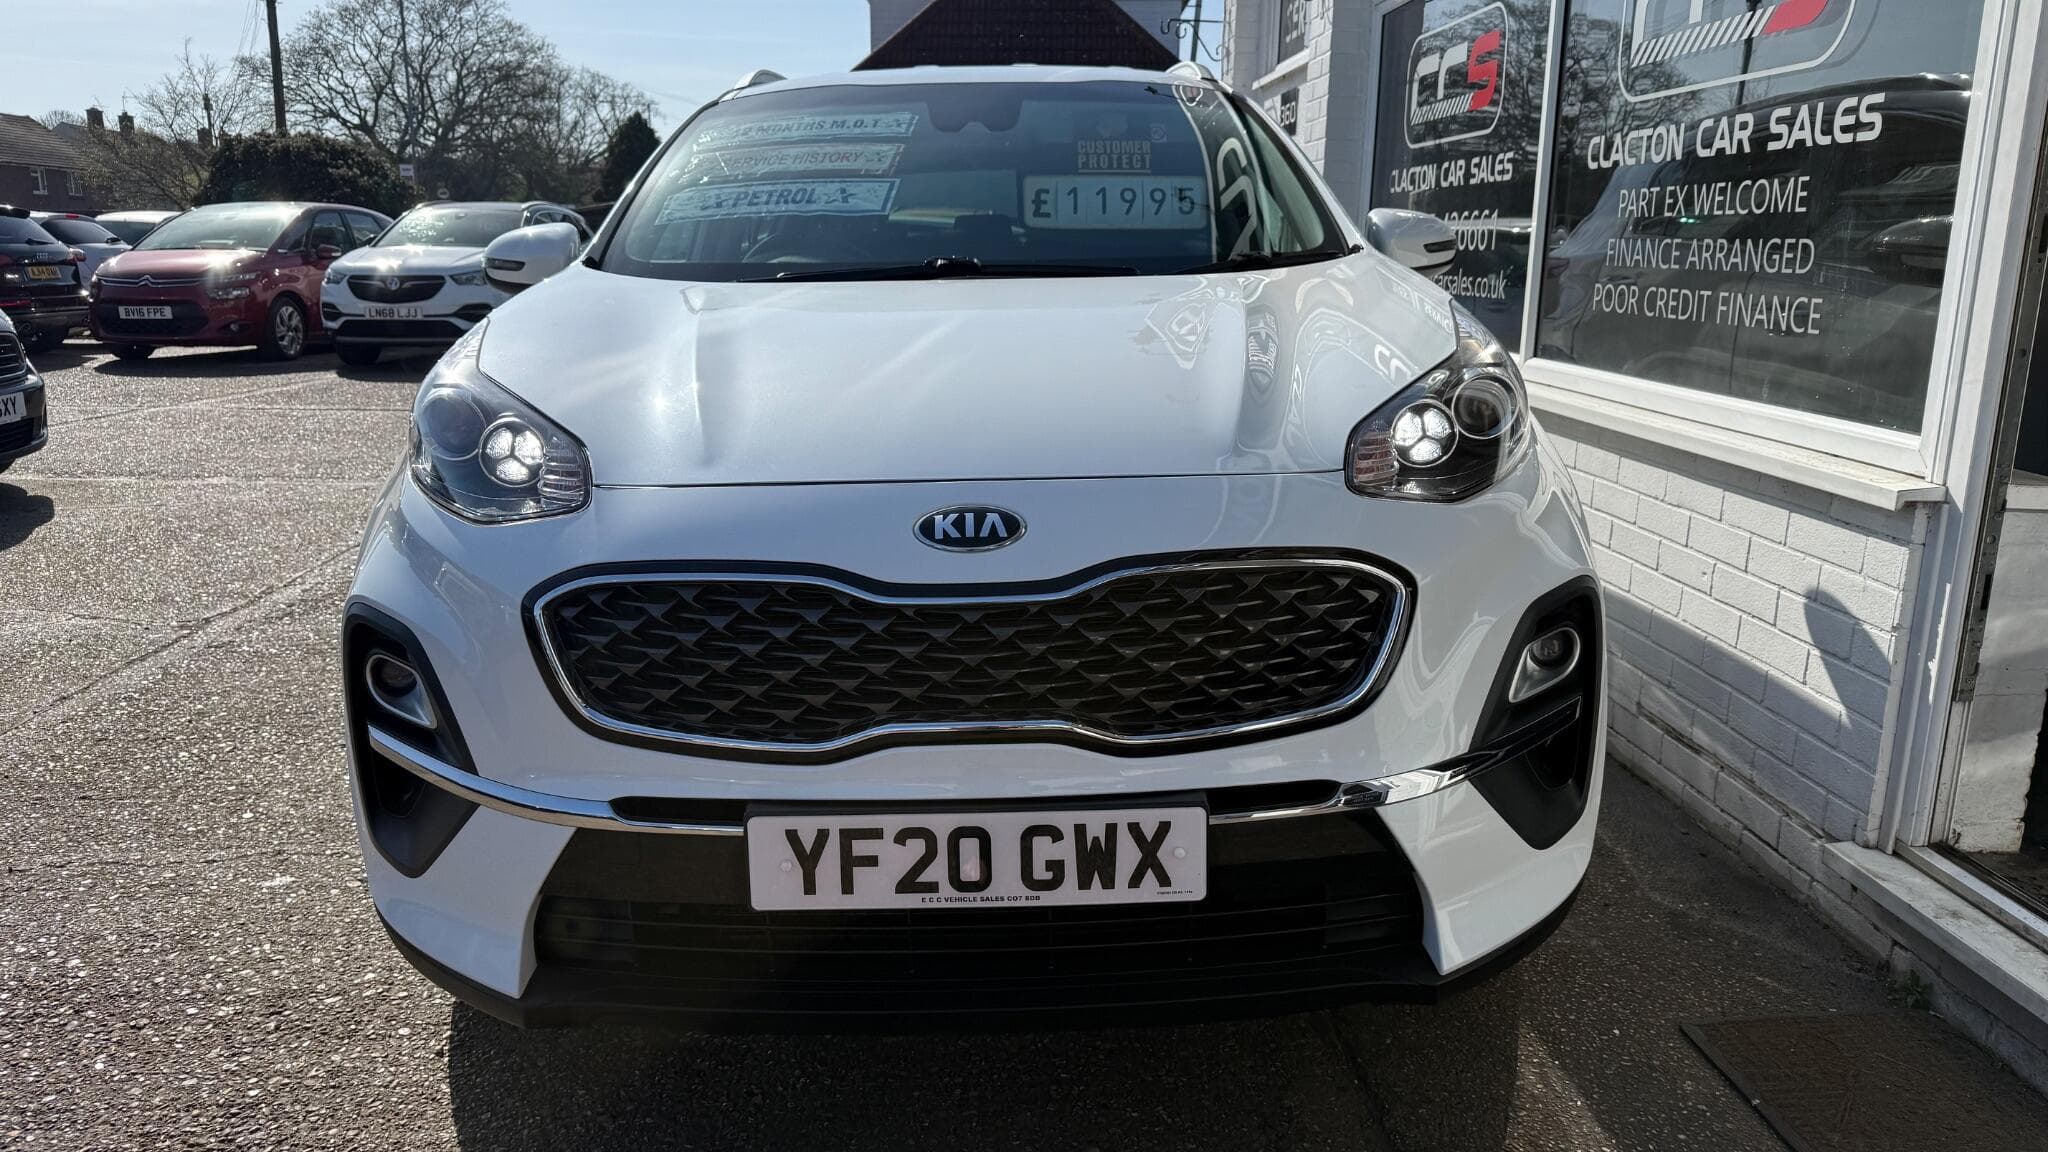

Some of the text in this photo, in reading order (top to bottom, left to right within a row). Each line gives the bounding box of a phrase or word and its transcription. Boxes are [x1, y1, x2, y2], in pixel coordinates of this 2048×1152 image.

[1078, 140, 1151, 154] CUSTOMER
[1587, 92, 1886, 170] CLACTON CAR SALES
[792, 151, 864, 165] HISTORY
[1078, 154, 1151, 169] PROTECT
[1440, 159, 1466, 188] CAR
[1470, 152, 1514, 184] SALES
[731, 188, 818, 208] PETROL
[1617, 176, 1811, 218] PART EX WELCOME
[1605, 238, 1816, 274] FINANCE ARRANGED
[124, 308, 145, 318] BV16
[1592, 283, 1823, 335] POOR CREDIT FINANCE
[933, 512, 1008, 540] KIA
[784, 820, 1173, 896] YF20 GWX
